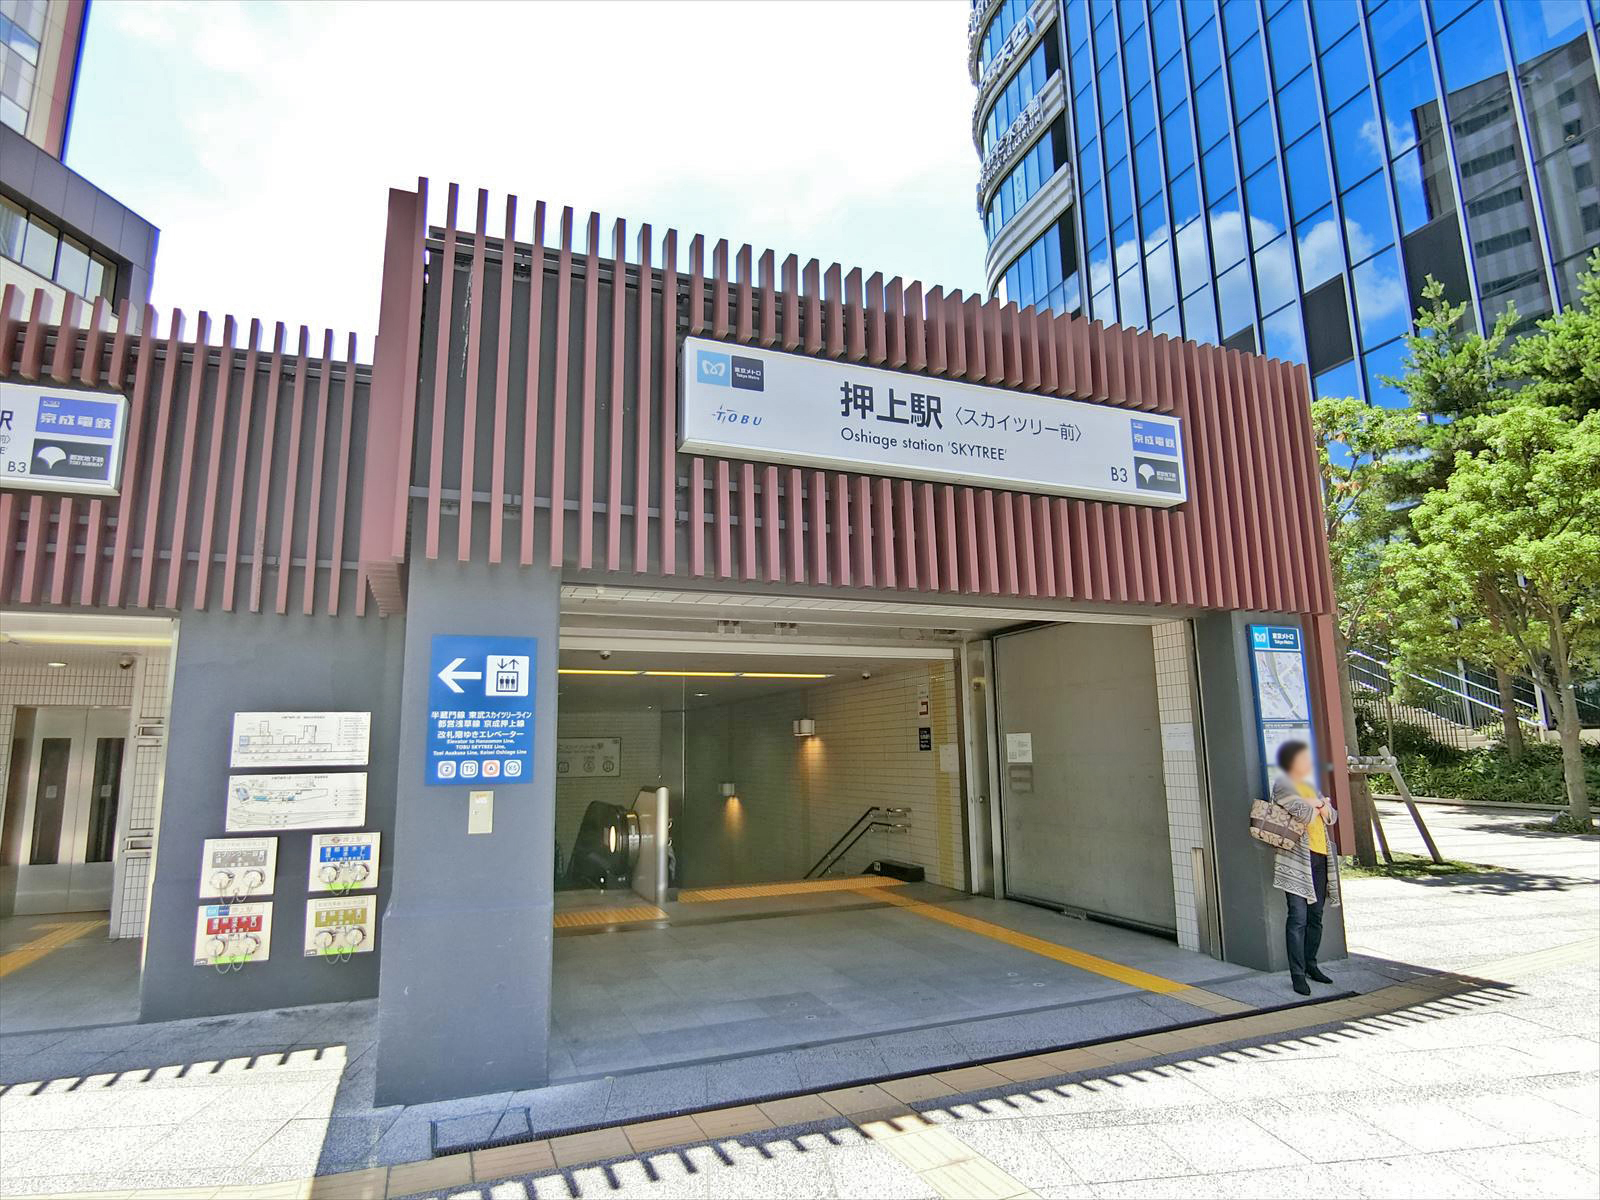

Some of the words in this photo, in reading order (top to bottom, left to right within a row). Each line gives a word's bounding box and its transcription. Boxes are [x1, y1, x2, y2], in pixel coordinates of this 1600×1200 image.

[734, 367, 762, 376] 東京メトロ
[840, 381, 943, 430] 押上駅
[41, 412, 112, 430] 京成電鉄
[716, 411, 762, 426] TOBU
[841, 427, 897, 450] Oshiage
[902, 438, 943, 453] station
[1134, 433, 1175, 448] 京成電鉄
[8, 460, 26, 473] B3
[1111, 466, 1128, 483] B3
